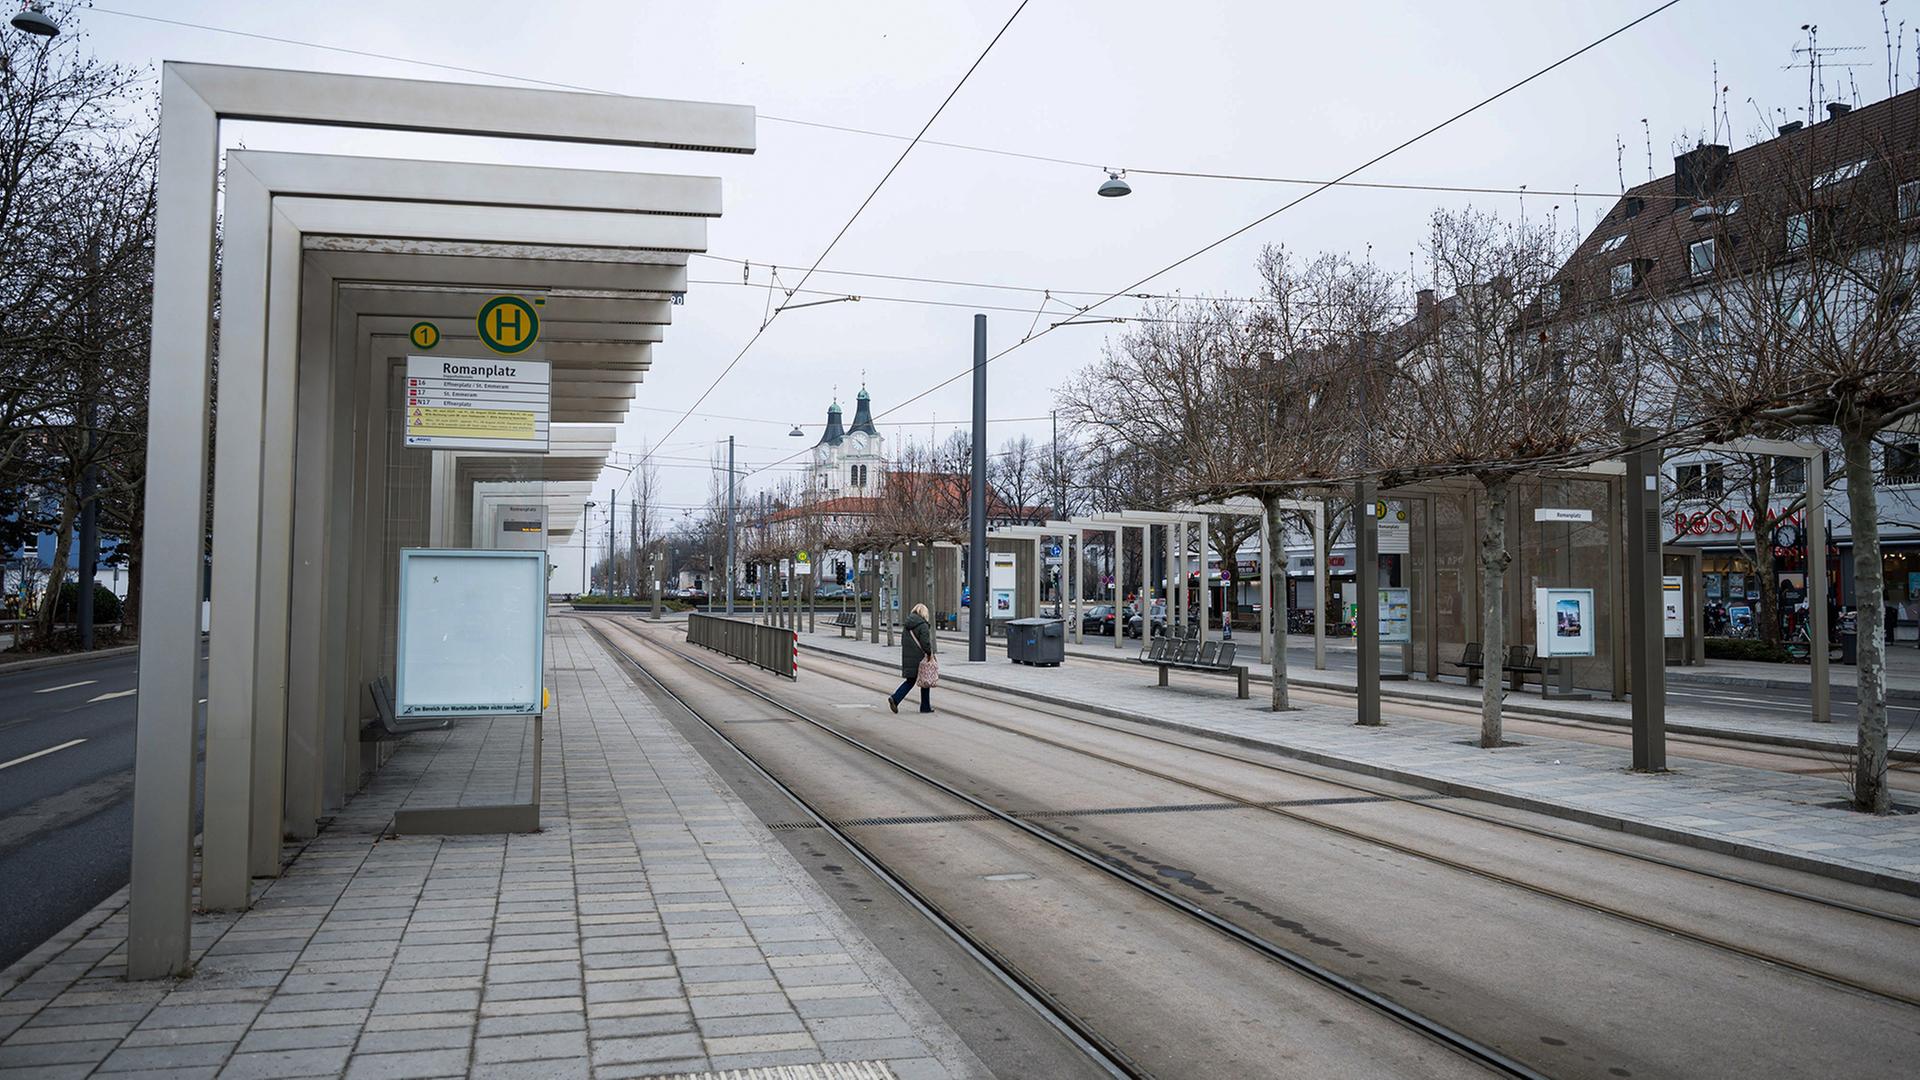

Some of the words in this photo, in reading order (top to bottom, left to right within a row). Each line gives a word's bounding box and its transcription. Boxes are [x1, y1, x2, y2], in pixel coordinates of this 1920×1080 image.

[496, 309, 520, 341] H
[420, 327, 428, 344] 1
[443, 363, 516, 378] Romanplatz
